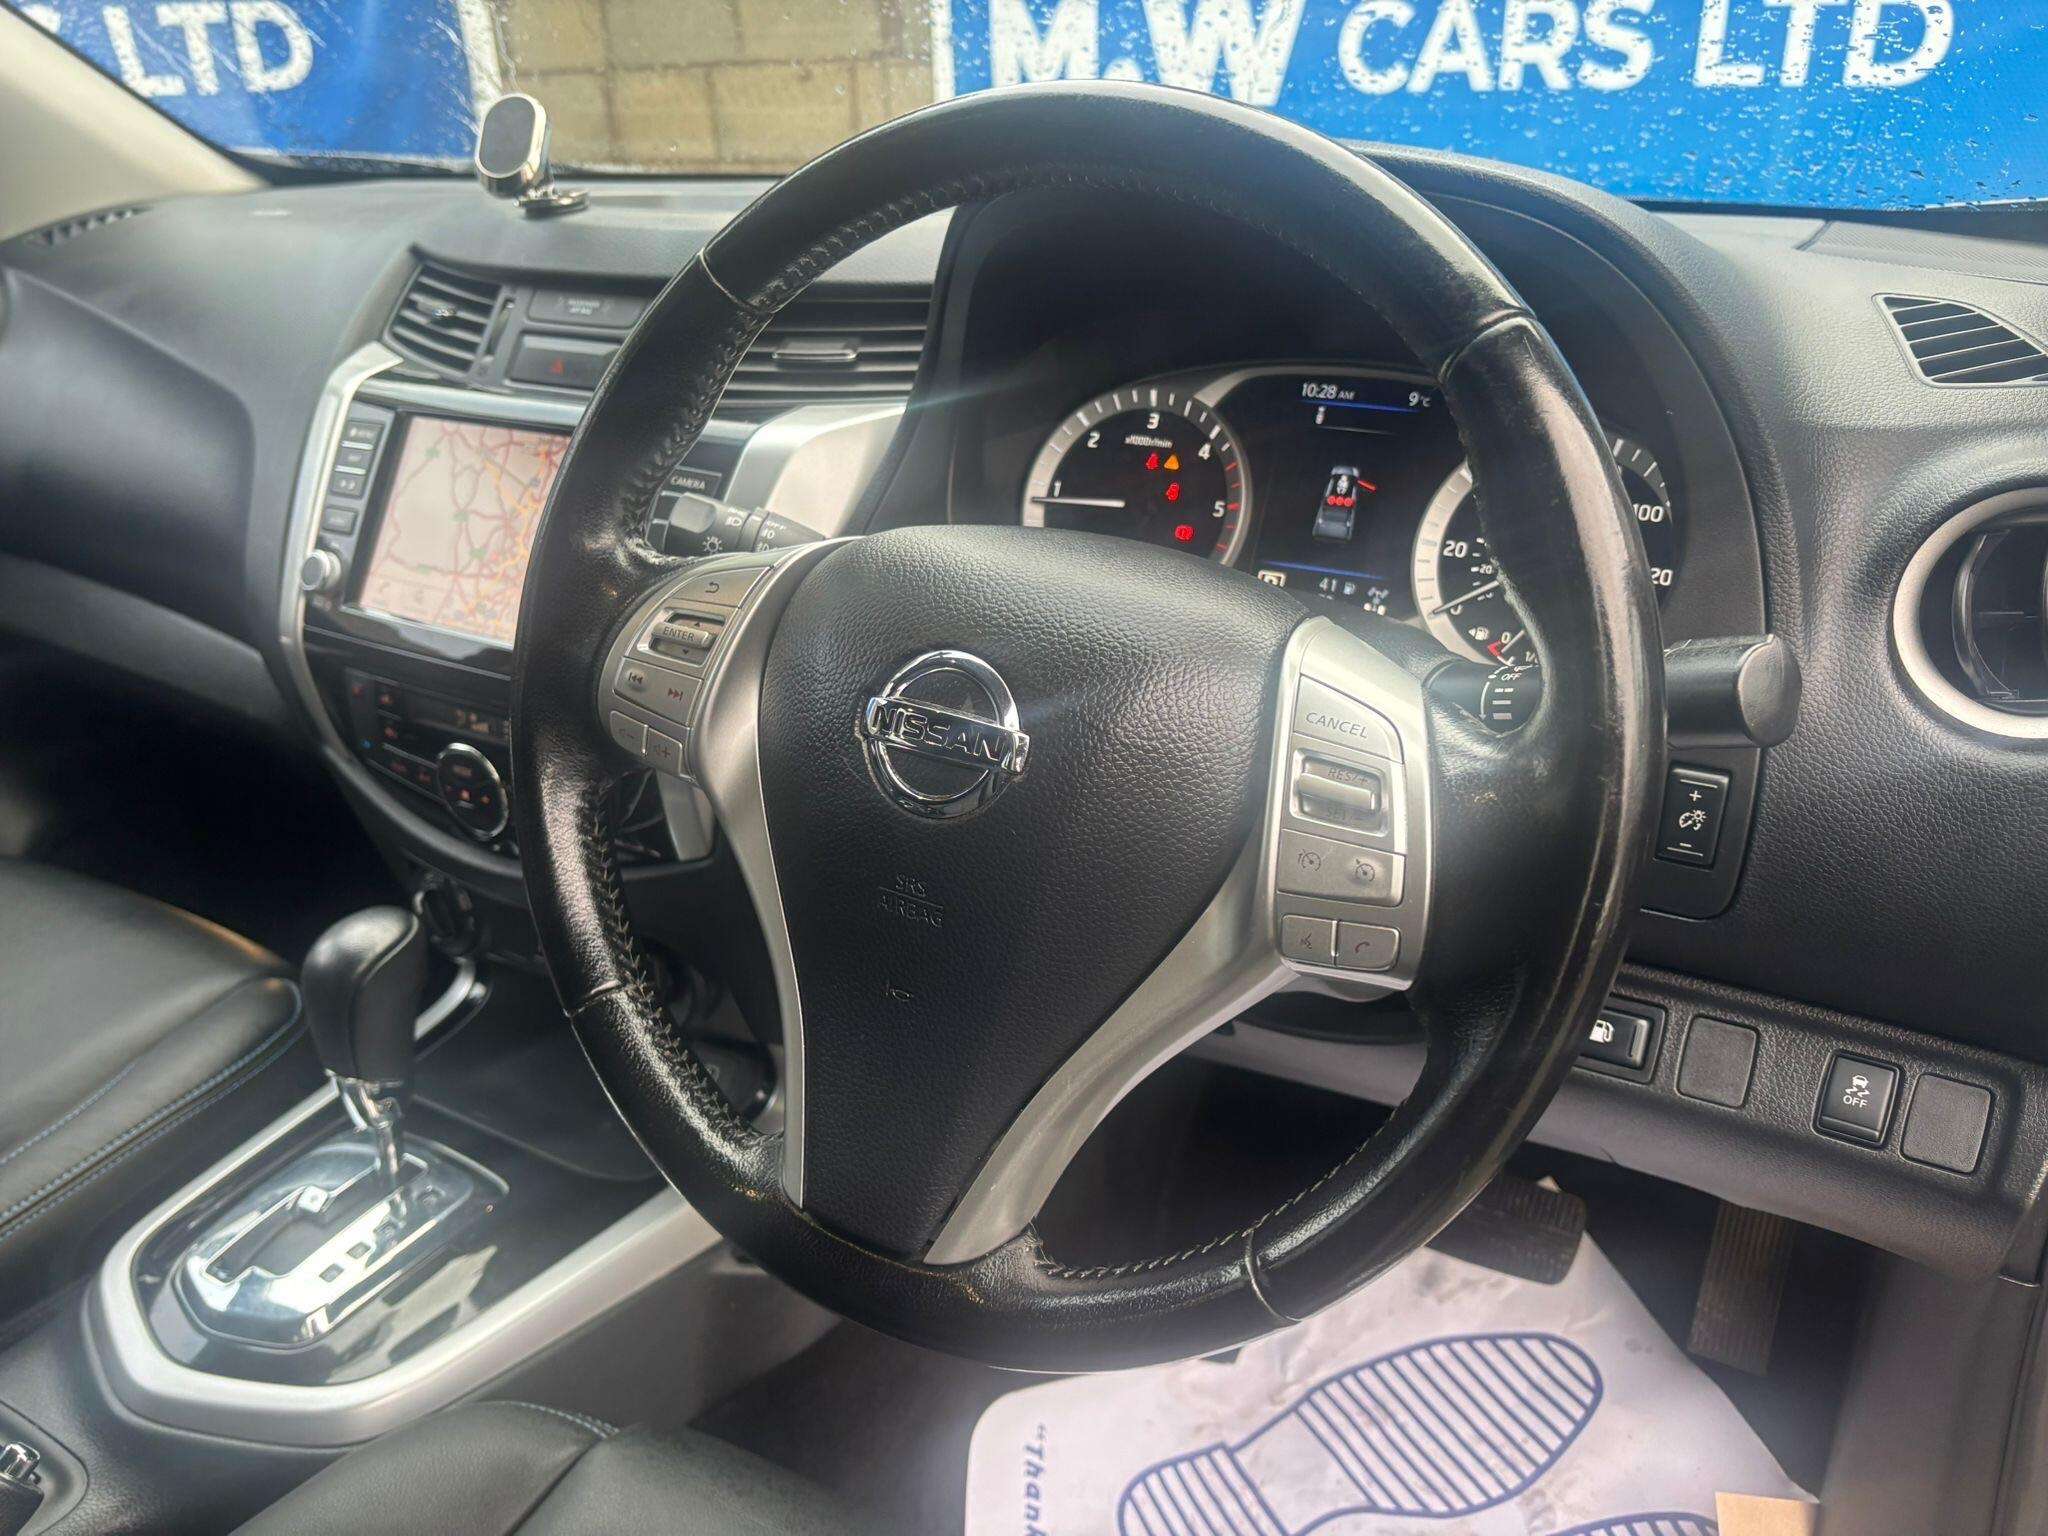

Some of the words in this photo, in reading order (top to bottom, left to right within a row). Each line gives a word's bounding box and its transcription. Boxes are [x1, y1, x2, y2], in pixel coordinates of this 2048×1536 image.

[102, 0, 313, 96] LTD
[1338, 0, 1655, 95] CARS
[1693, 0, 1954, 87] LTD
[1301, 382, 1338, 399] 10:28
[1147, 412, 1160, 429] 3
[1087, 430, 1100, 448] 2
[1198, 442, 1211, 460] 4
[670, 476, 706, 490] CAMERA
[1053, 480, 1062, 498] 1
[1212, 500, 1225, 518] 5
[1443, 540, 1468, 558] 20
[1319, 577, 1337, 592] 41
[663, 626, 695, 641] ENTER
[1501, 631, 1511, 644] 0
[1501, 672, 1522, 681] OFF
[870, 704, 1004, 763] NISSAN
[1305, 712, 1368, 739] CANCEL
[1842, 1094, 1868, 1108] OFF
